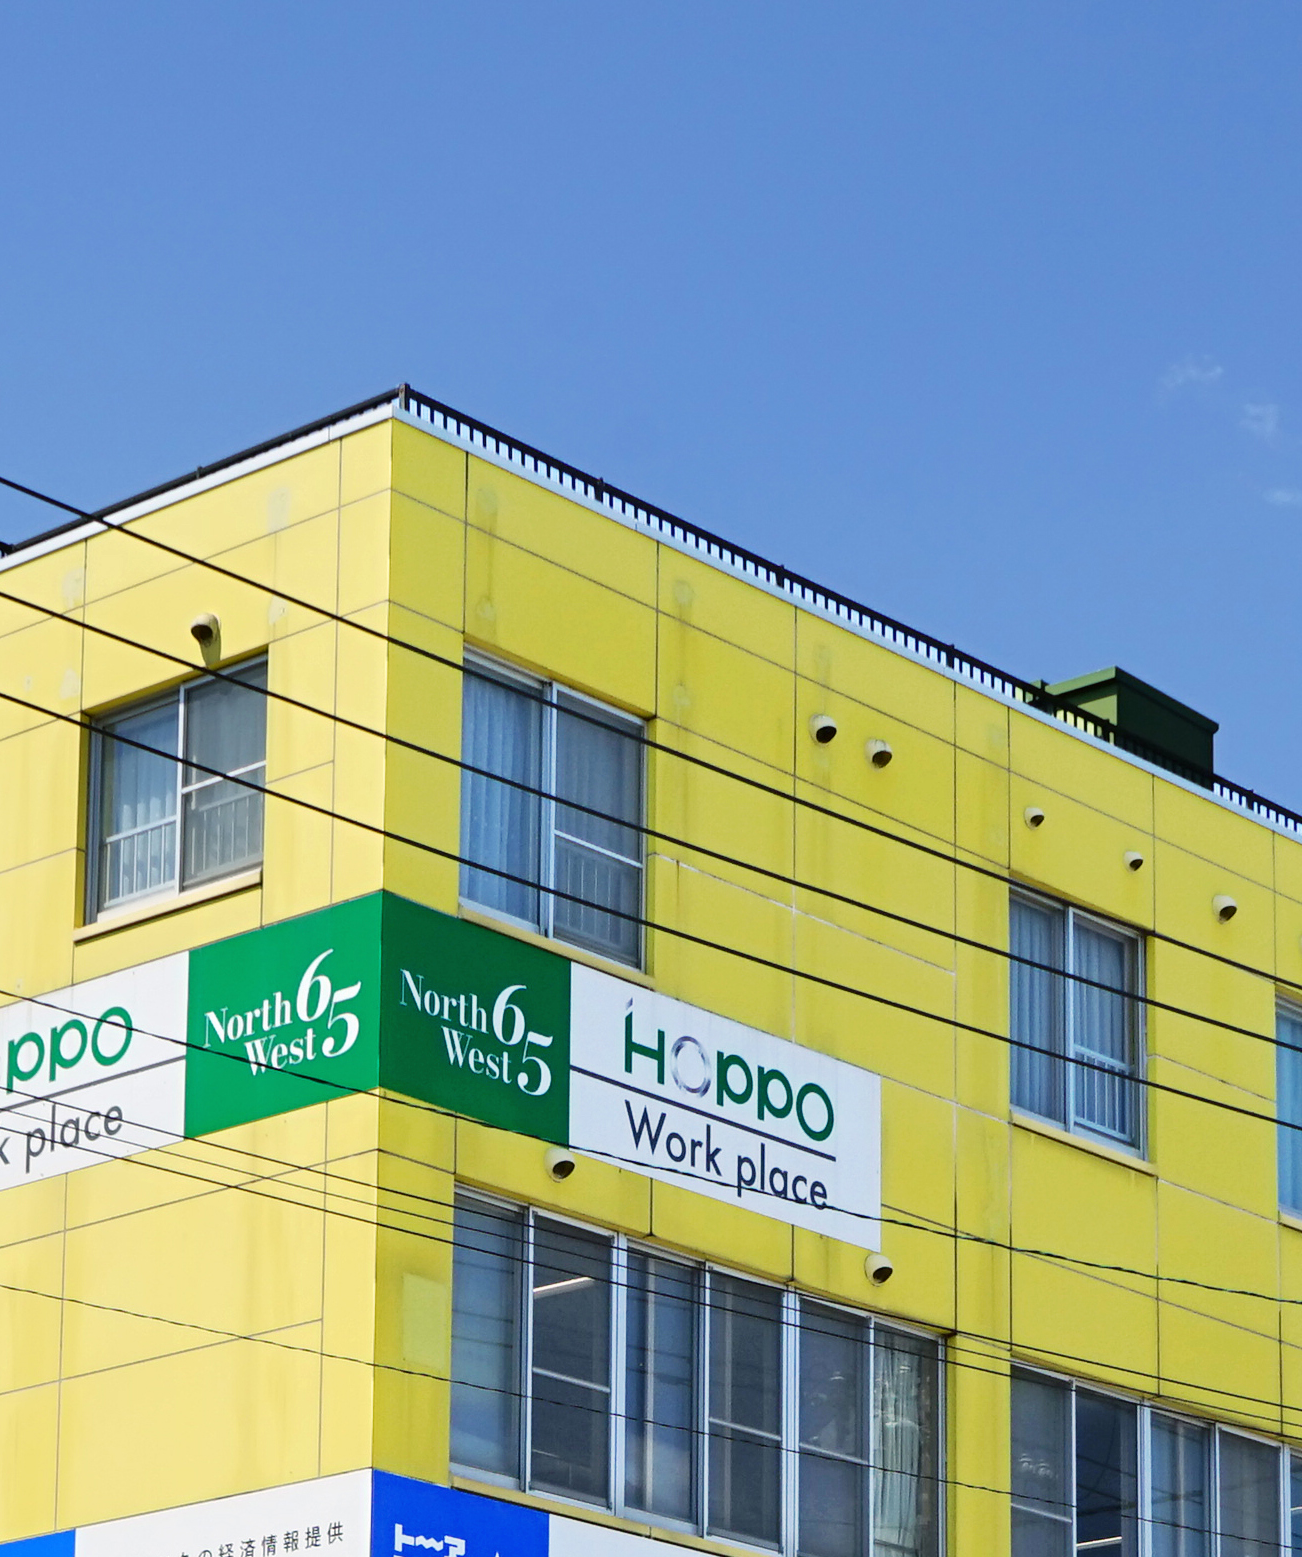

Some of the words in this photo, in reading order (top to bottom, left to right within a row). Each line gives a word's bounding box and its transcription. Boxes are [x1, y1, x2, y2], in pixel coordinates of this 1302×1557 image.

[203, 992, 291, 1049] North
[295, 948, 335, 1023] 6
[244, 1030, 316, 1077] West
[322, 980, 362, 1058] 5
[400, 968, 489, 1034] North
[492, 985, 528, 1046] 6
[441, 1025, 513, 1085] West
[517, 1031, 554, 1096] 5
[24, 1102, 124, 1174] place
[625, 1099, 723, 1177] Work
[736, 1142, 828, 1210] place
